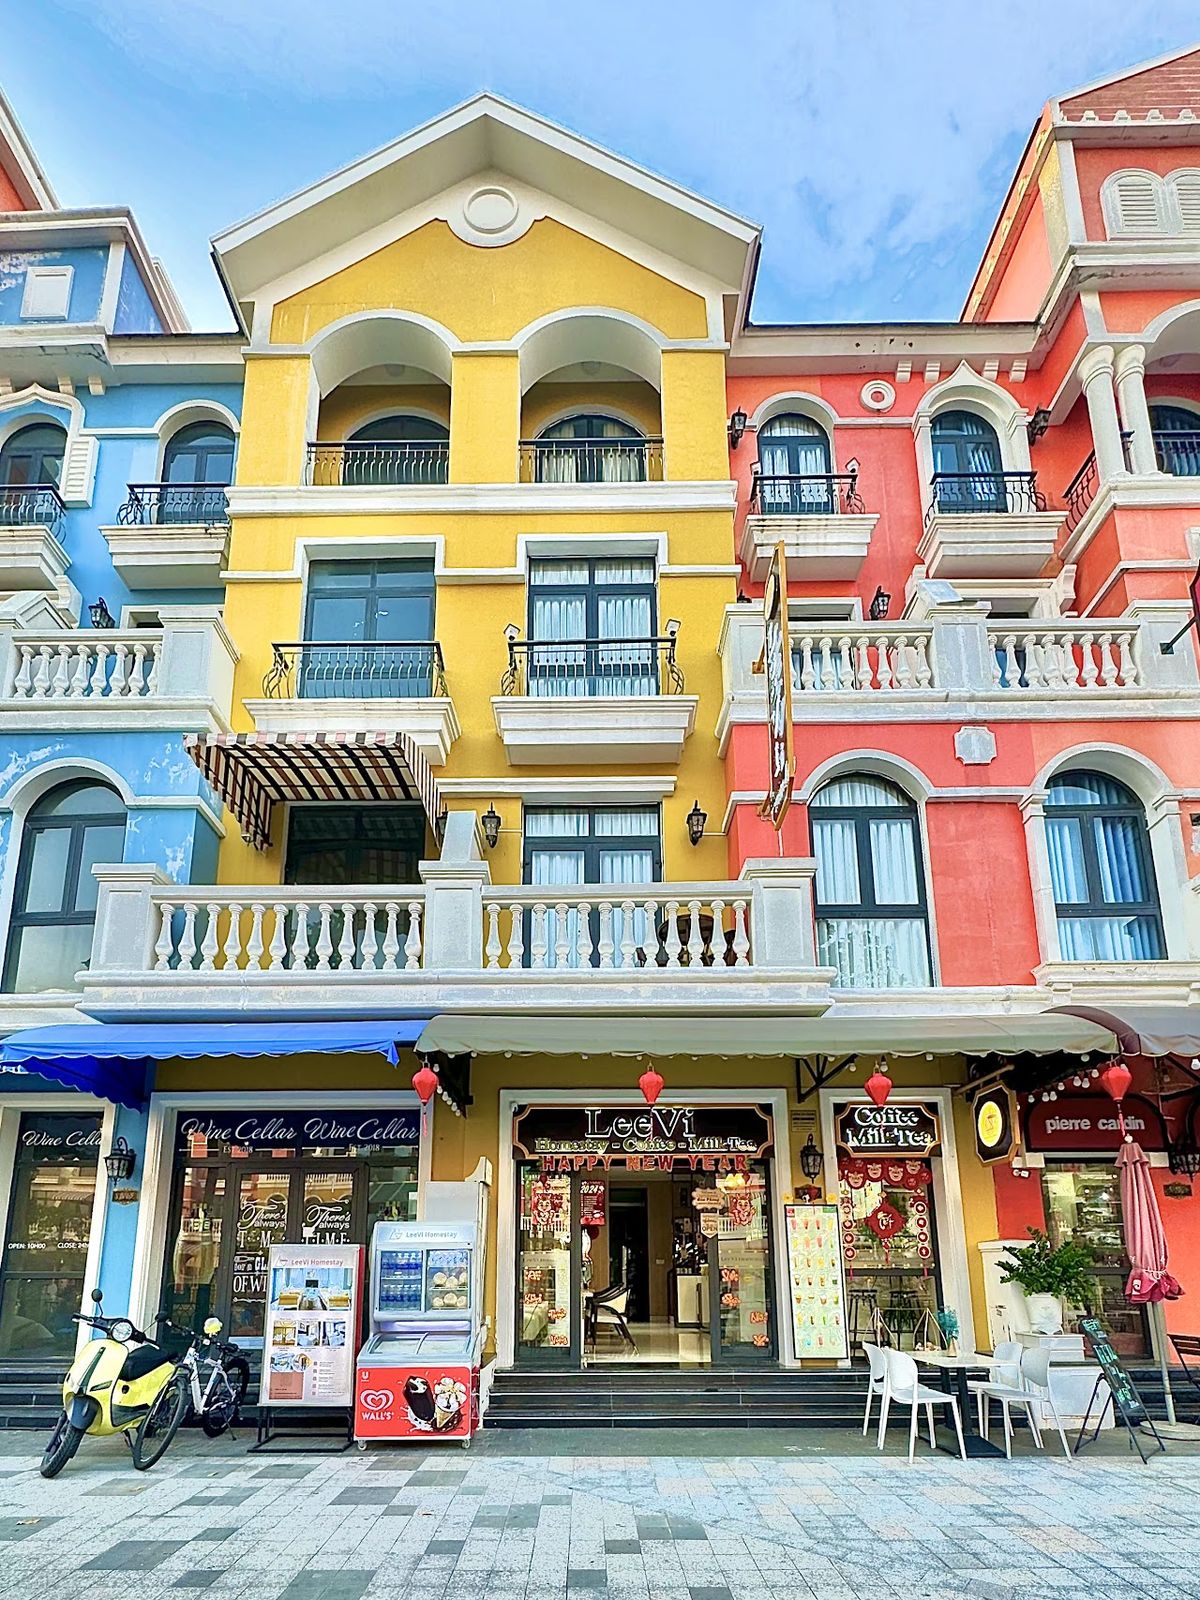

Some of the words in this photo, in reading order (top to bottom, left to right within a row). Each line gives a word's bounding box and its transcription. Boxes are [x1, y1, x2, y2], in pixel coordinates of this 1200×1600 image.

[585, 1107, 697, 1138] LeeVi
[854, 1106, 920, 1127] Coffee
[1045, 1116, 1091, 1134] pierre
[181, 1118, 232, 1140] Wine
[235, 1117, 297, 1140] Cellar
[304, 1117, 357, 1140] Wine
[357, 1117, 419, 1140] Cellar
[846, 1127, 897, 1147] Milk
[893, 1127, 933, 1147] Tea
[22, 1130, 63, 1146] Wine
[535, 1138, 609, 1155] Homestay
[623, 1137, 677, 1152] Coffee
[541, 1154, 613, 1172] HAPPY
[626, 1154, 674, 1173] NEW
[688, 1154, 747, 1172] YEAR
[580, 1185, 599, 1194] 2024
[254, 1221, 284, 1231] always
[302, 1205, 351, 1231] There's
[318, 1220, 350, 1230] always
[406, 1231, 424, 1239] LeeVi
[425, 1231, 457, 1239] Homestay
[291, 1259, 309, 1267] LeeVi
[311, 1259, 343, 1267] Homestay
[233, 1275, 248, 1292] OF
[361, 1411, 393, 1420] WALL'S
